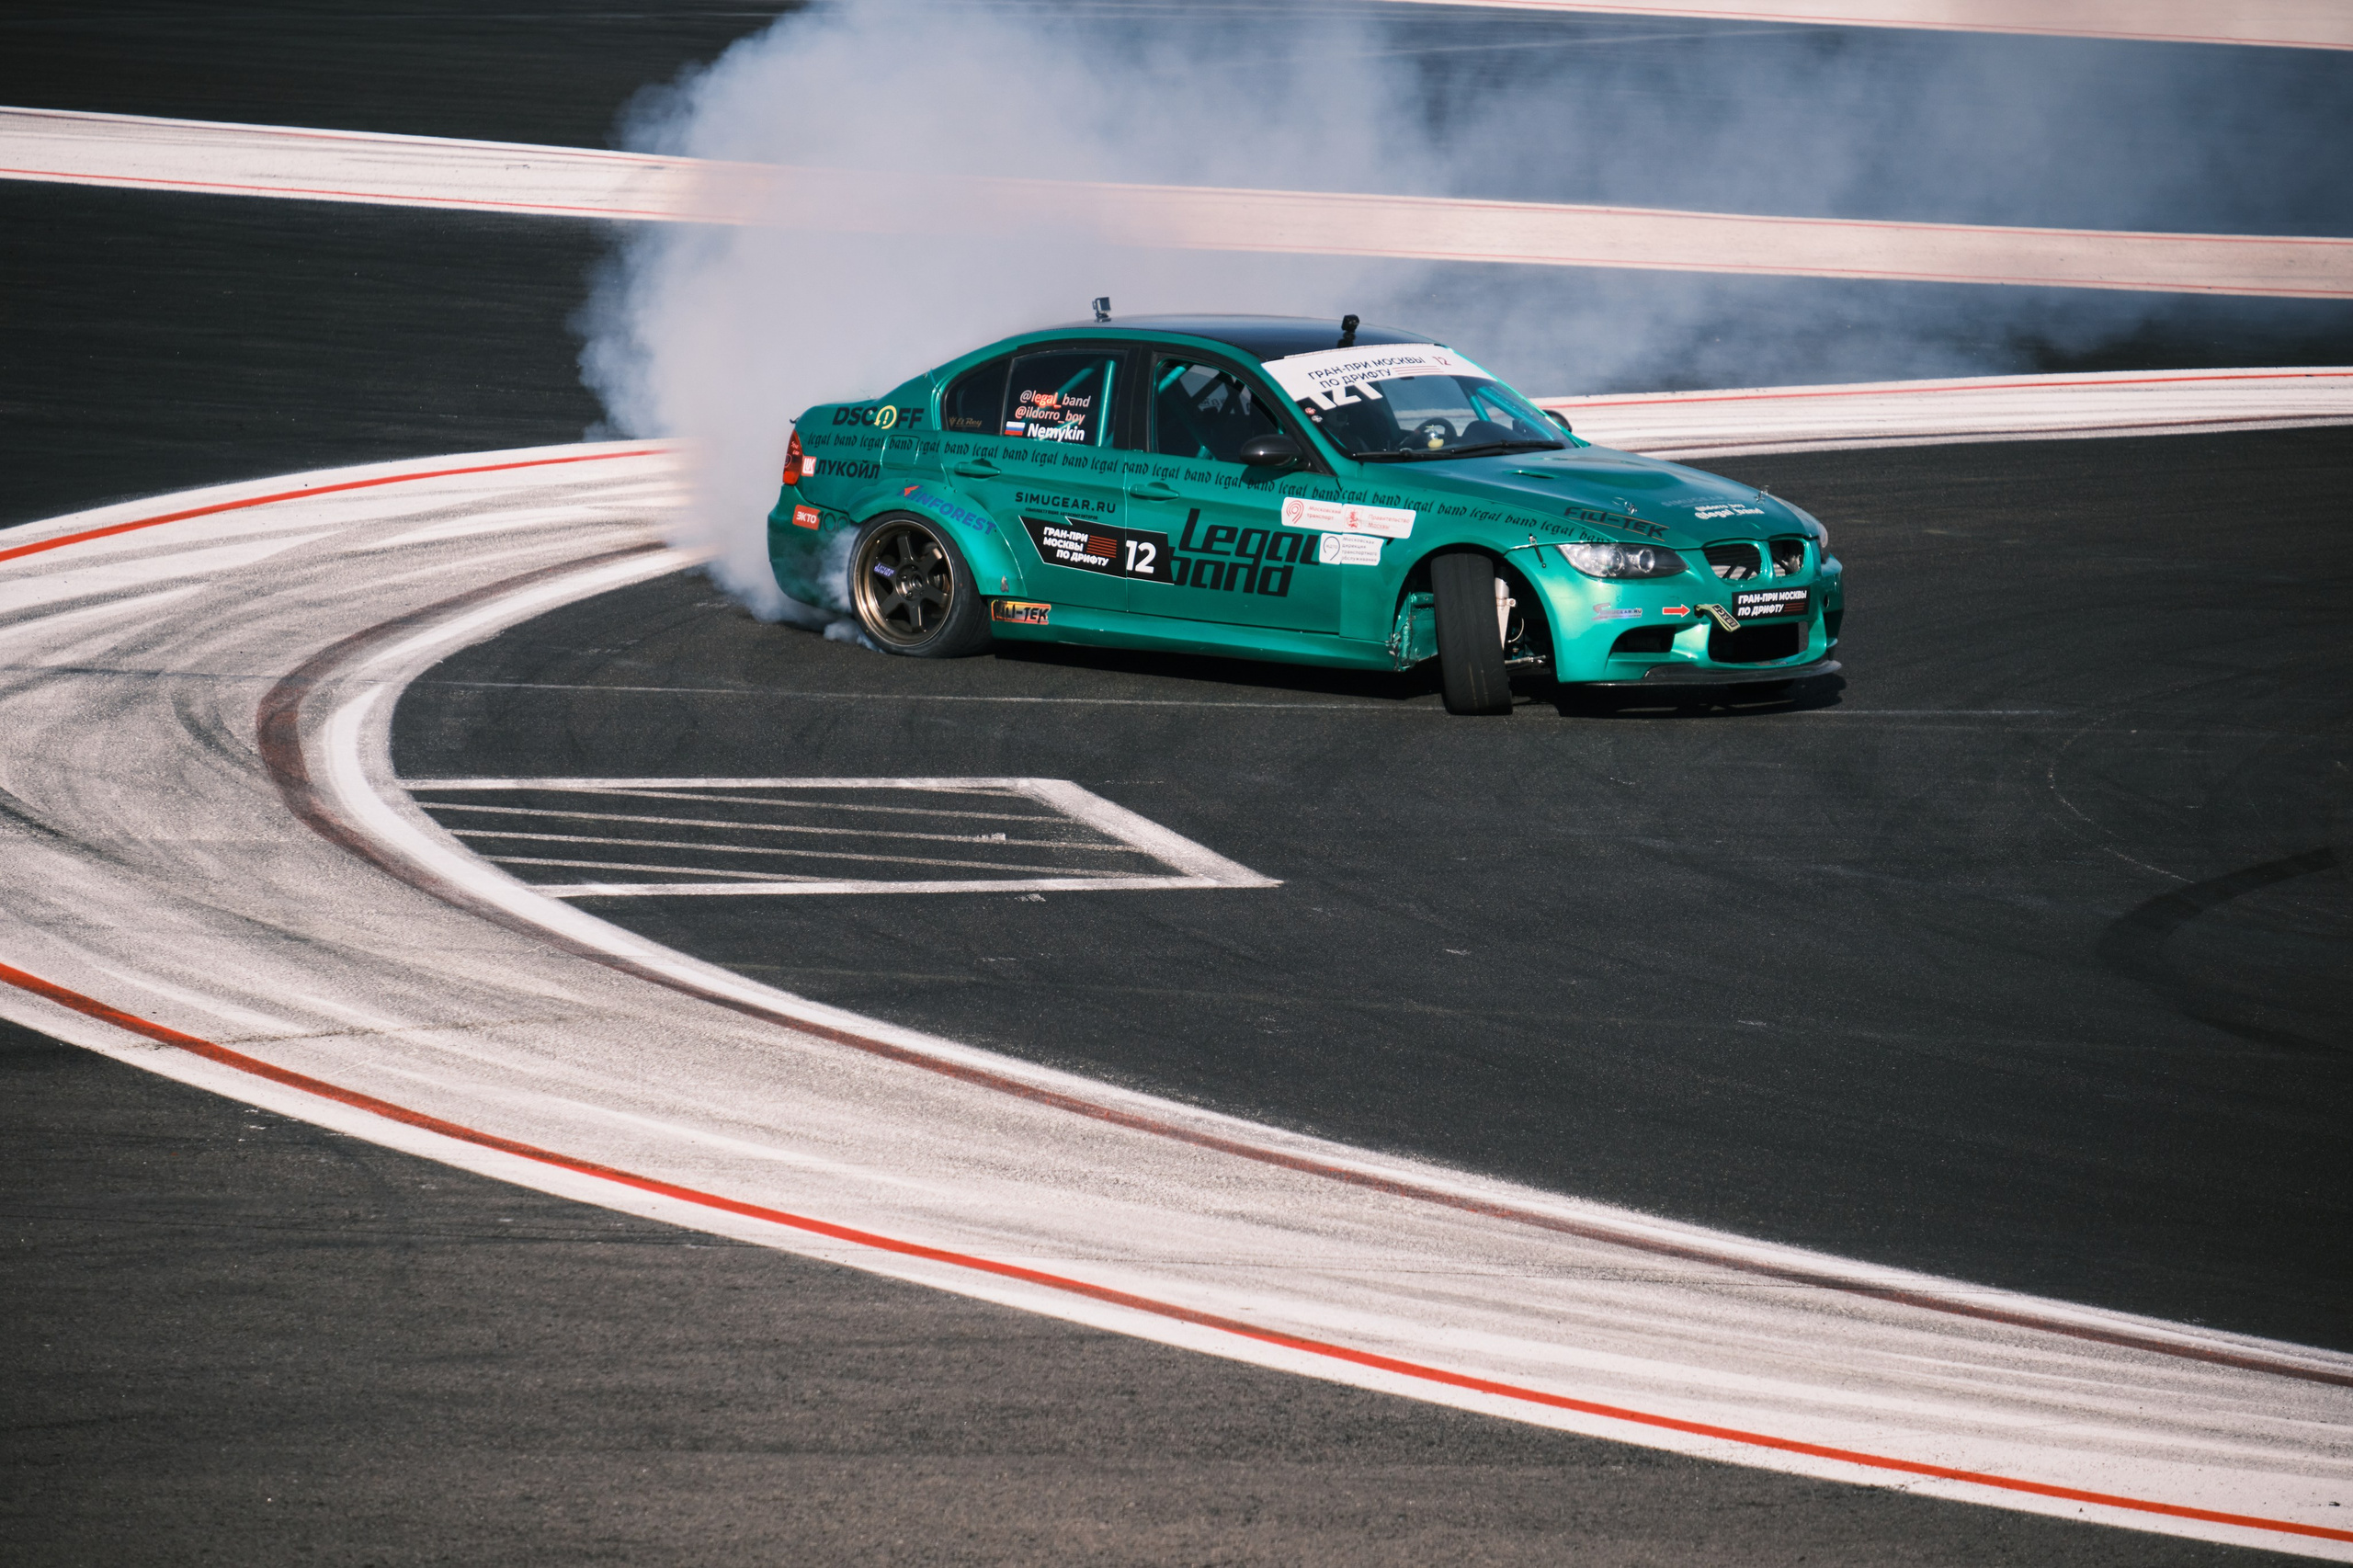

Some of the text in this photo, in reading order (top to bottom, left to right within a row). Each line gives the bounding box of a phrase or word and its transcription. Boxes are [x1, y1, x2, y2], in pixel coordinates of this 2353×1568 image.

[1307, 357, 1426, 381] ГРАН-ПРИ МОСКВЫ
[1432, 356, 1452, 366] 12
[1319, 369, 1392, 389] ПО ДРИФТУ
[1020, 390, 1091, 408] @legal_band
[1015, 405, 1086, 425] @ildorro_boy
[1027, 423, 1086, 442] Nemykin
[816, 460, 881, 480] ЛУКОЙЛ
[808, 432, 830, 449] legal
[834, 434, 857, 448] band
[860, 436, 884, 451] legal
[889, 437, 913, 450] band
[916, 438, 940, 454] legal
[944, 440, 969, 456] band
[972, 443, 998, 460] legal
[1003, 446, 1028, 461] band
[1031, 449, 1058, 467] legal
[1063, 452, 1087, 469] band
[1091, 455, 1118, 474] legal
[1123, 460, 1148, 475] band
[1153, 462, 1180, 481] legal
[1184, 468, 1211, 483] band
[1215, 472, 1242, 490] legal
[1247, 477, 1275, 493] band
[1279, 479, 1308, 498] legal
[1311, 486, 1340, 501] band
[1372, 492, 1401, 506] band
[1404, 496, 1433, 514] legal
[1438, 501, 1467, 517] band
[1470, 506, 1502, 522] legal
[1506, 514, 1537, 528] band
[1540, 517, 1574, 538] legal
[1016, 492, 1117, 514] SIMUGEAR.RU
[796, 511, 817, 524] ЭКТО
[1563, 507, 1668, 538] FILI-TEK
[1043, 526, 1088, 542] ГРАН-ПРИ
[1178, 507, 1320, 565] Legal
[1043, 537, 1084, 552] МОСКВЫ
[1056, 549, 1109, 567] ПО ДРИФТУ
[1125, 540, 1157, 574] 12
[1168, 546, 1294, 597] band
[1737, 590, 1807, 605] ГРАН-ПРИ МОСКВЫ
[1737, 606, 1751, 617] ПО
[1751, 603, 1785, 617] ДРИФТУ
